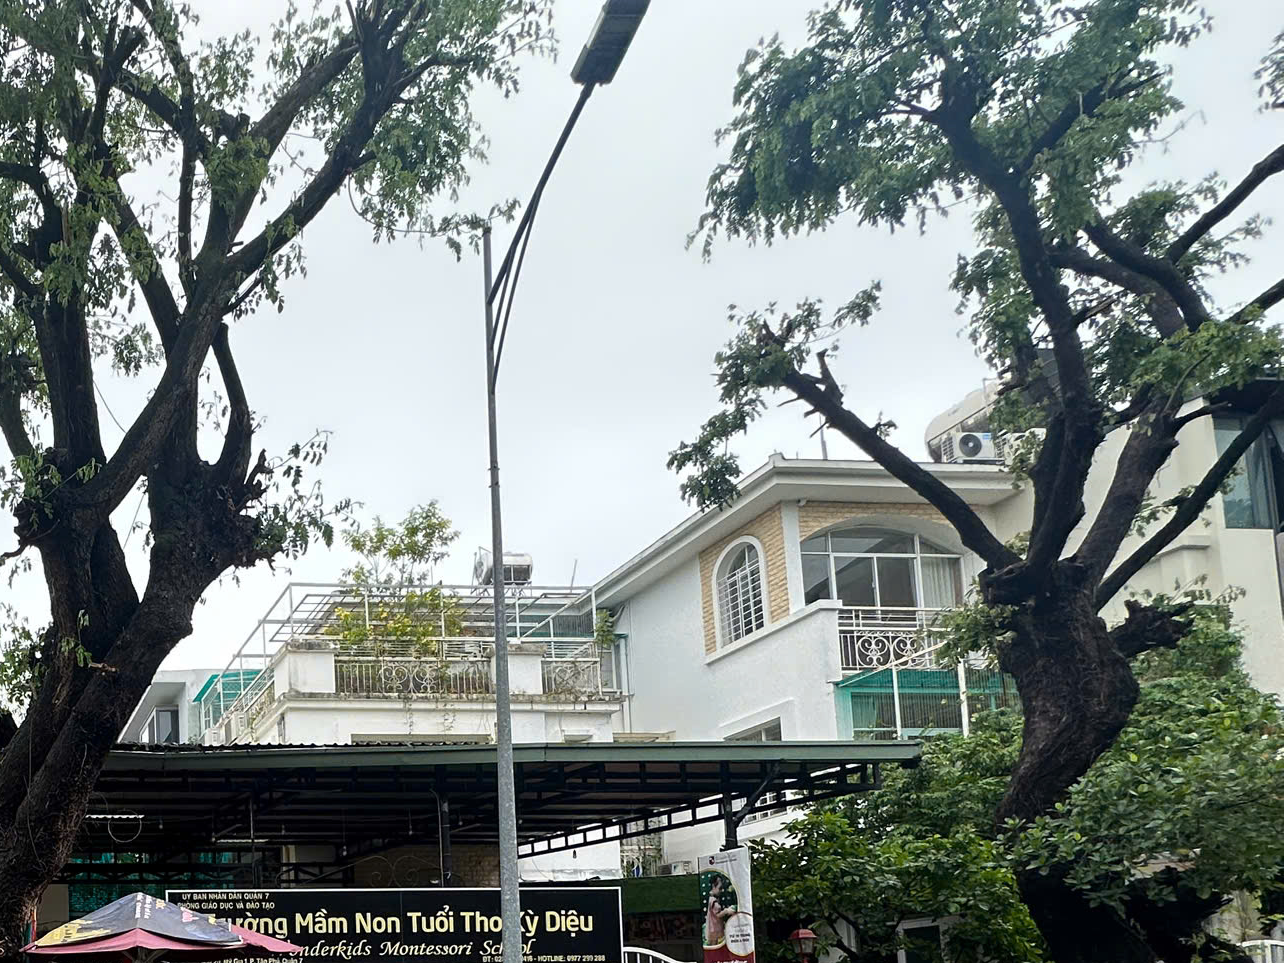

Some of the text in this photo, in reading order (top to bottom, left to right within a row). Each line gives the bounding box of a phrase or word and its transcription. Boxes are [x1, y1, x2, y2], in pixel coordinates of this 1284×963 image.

[201, 901, 218, 910] GIÁO
[219, 902, 234, 911] DỤC
[236, 901, 244, 909] VÀ
[261, 902, 275, 911] TẠO
[295, 908, 348, 934] Mầm
[355, 912, 401, 934] Non
[407, 905, 455, 933] Tuổi
[545, 909, 593, 937] Diệu
[288, 939, 537, 960] nderkids Montessori Scol
